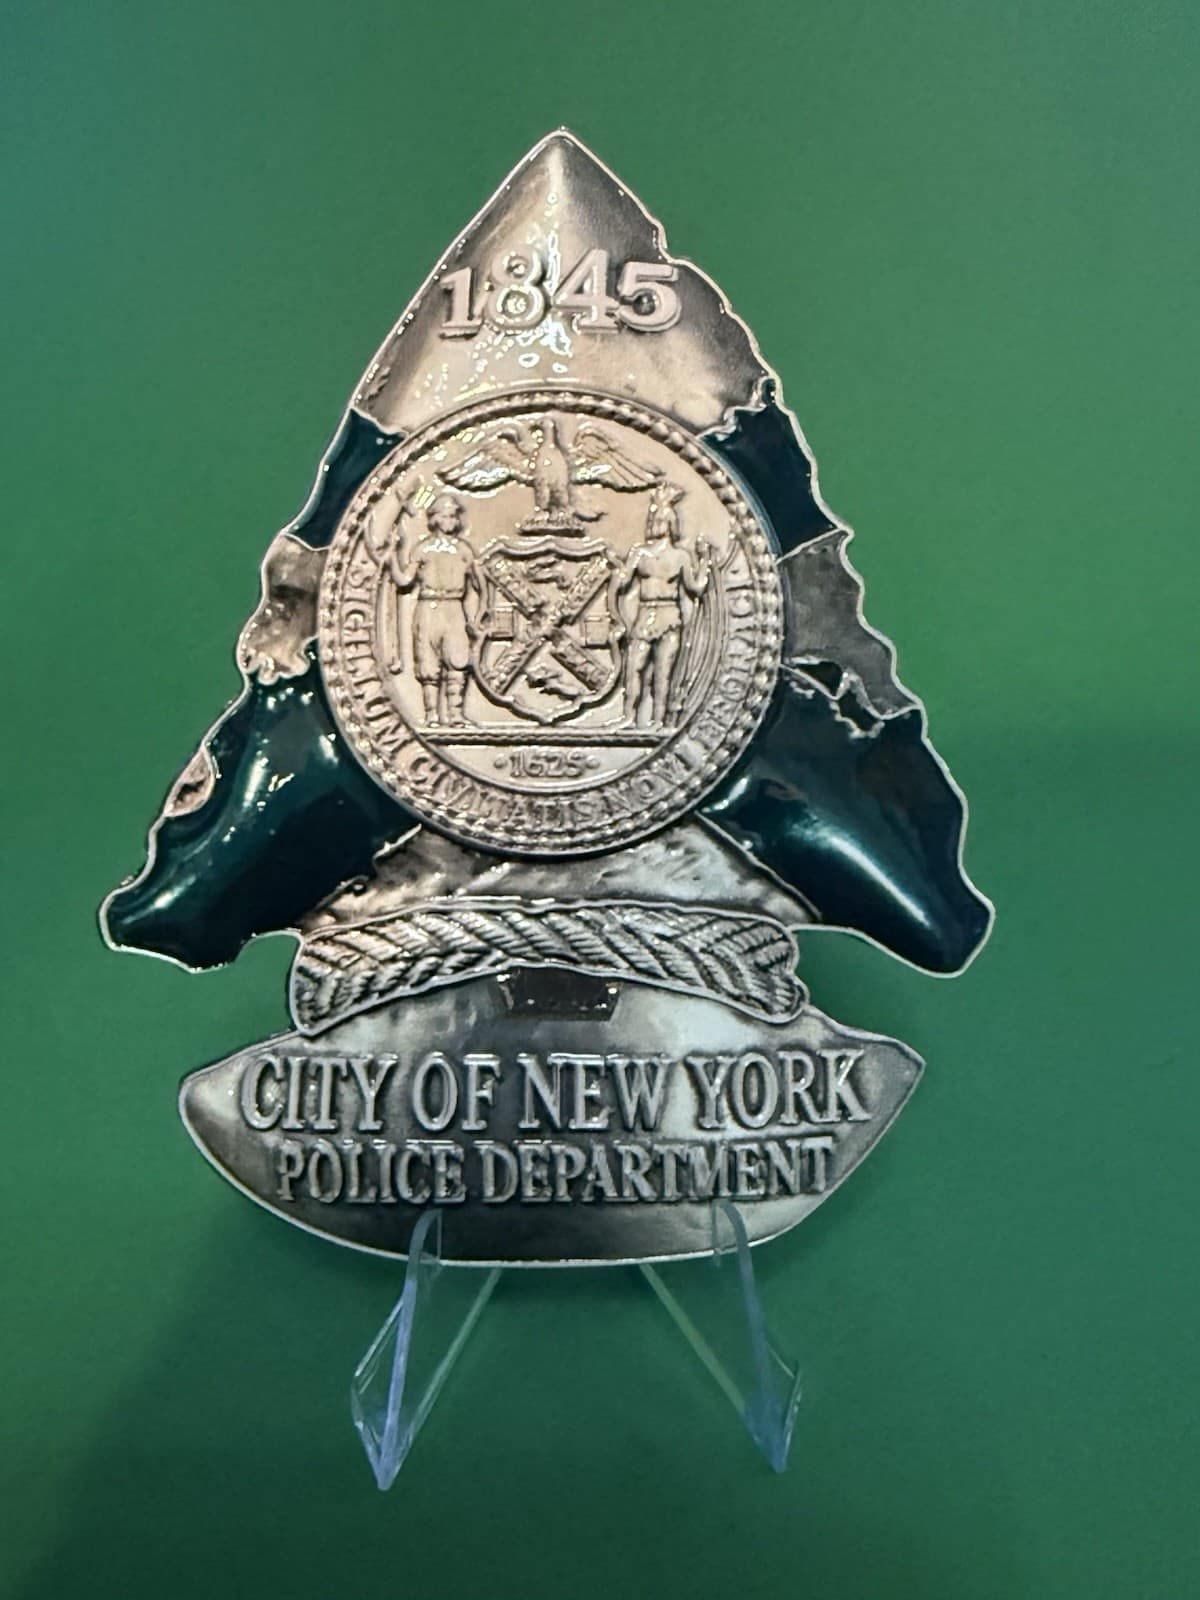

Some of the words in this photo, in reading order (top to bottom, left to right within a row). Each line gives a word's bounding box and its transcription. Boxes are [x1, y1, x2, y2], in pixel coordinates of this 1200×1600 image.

[439, 248, 682, 337] 1845
[508, 750, 585, 778] 1625
[241, 1053, 398, 1131] CITY
[412, 1051, 501, 1131] OF
[516, 1052, 678, 1131] NEW
[685, 1049, 872, 1130] YORK
[276, 1138, 466, 1204] POLICE
[473, 1136, 834, 1204] DEPARTMENT
